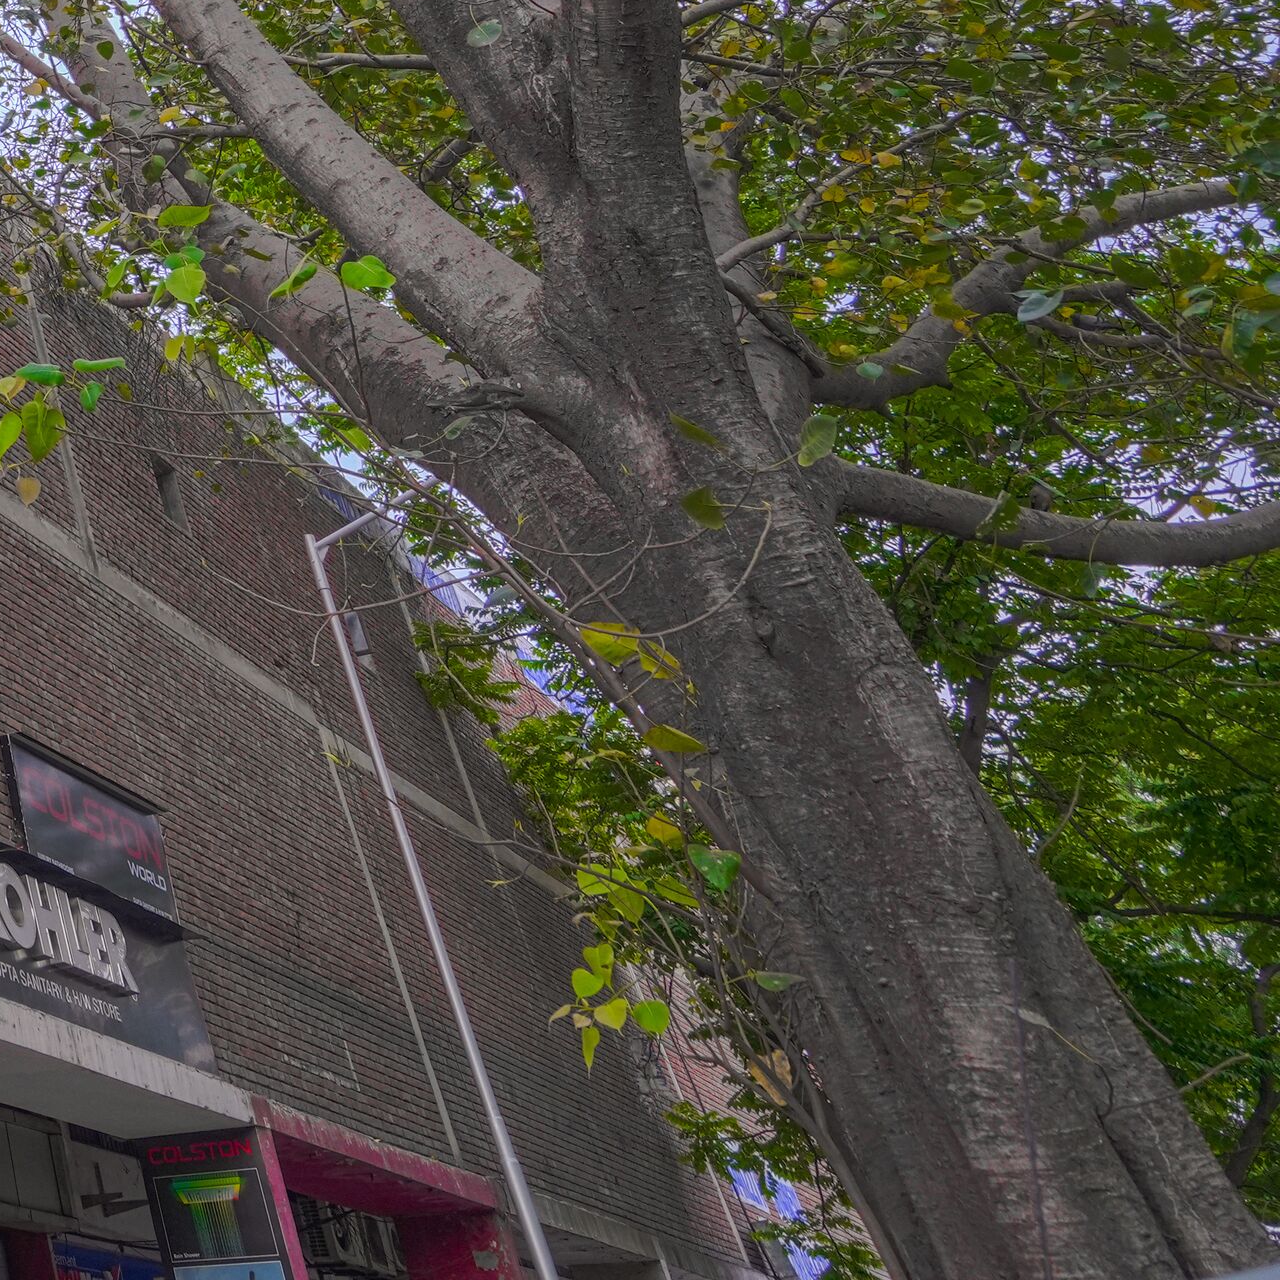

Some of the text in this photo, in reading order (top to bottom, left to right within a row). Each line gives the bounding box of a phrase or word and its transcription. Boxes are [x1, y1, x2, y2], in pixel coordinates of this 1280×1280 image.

[127, 859, 167, 891] WORLD
[20, 969, 62, 999] SANITARY
[65, 987, 72, 1003] &
[72, 990, 91, 1010] H/W
[92, 998, 122, 1023] STORE
[147, 1139, 252, 1165] COLSTON
